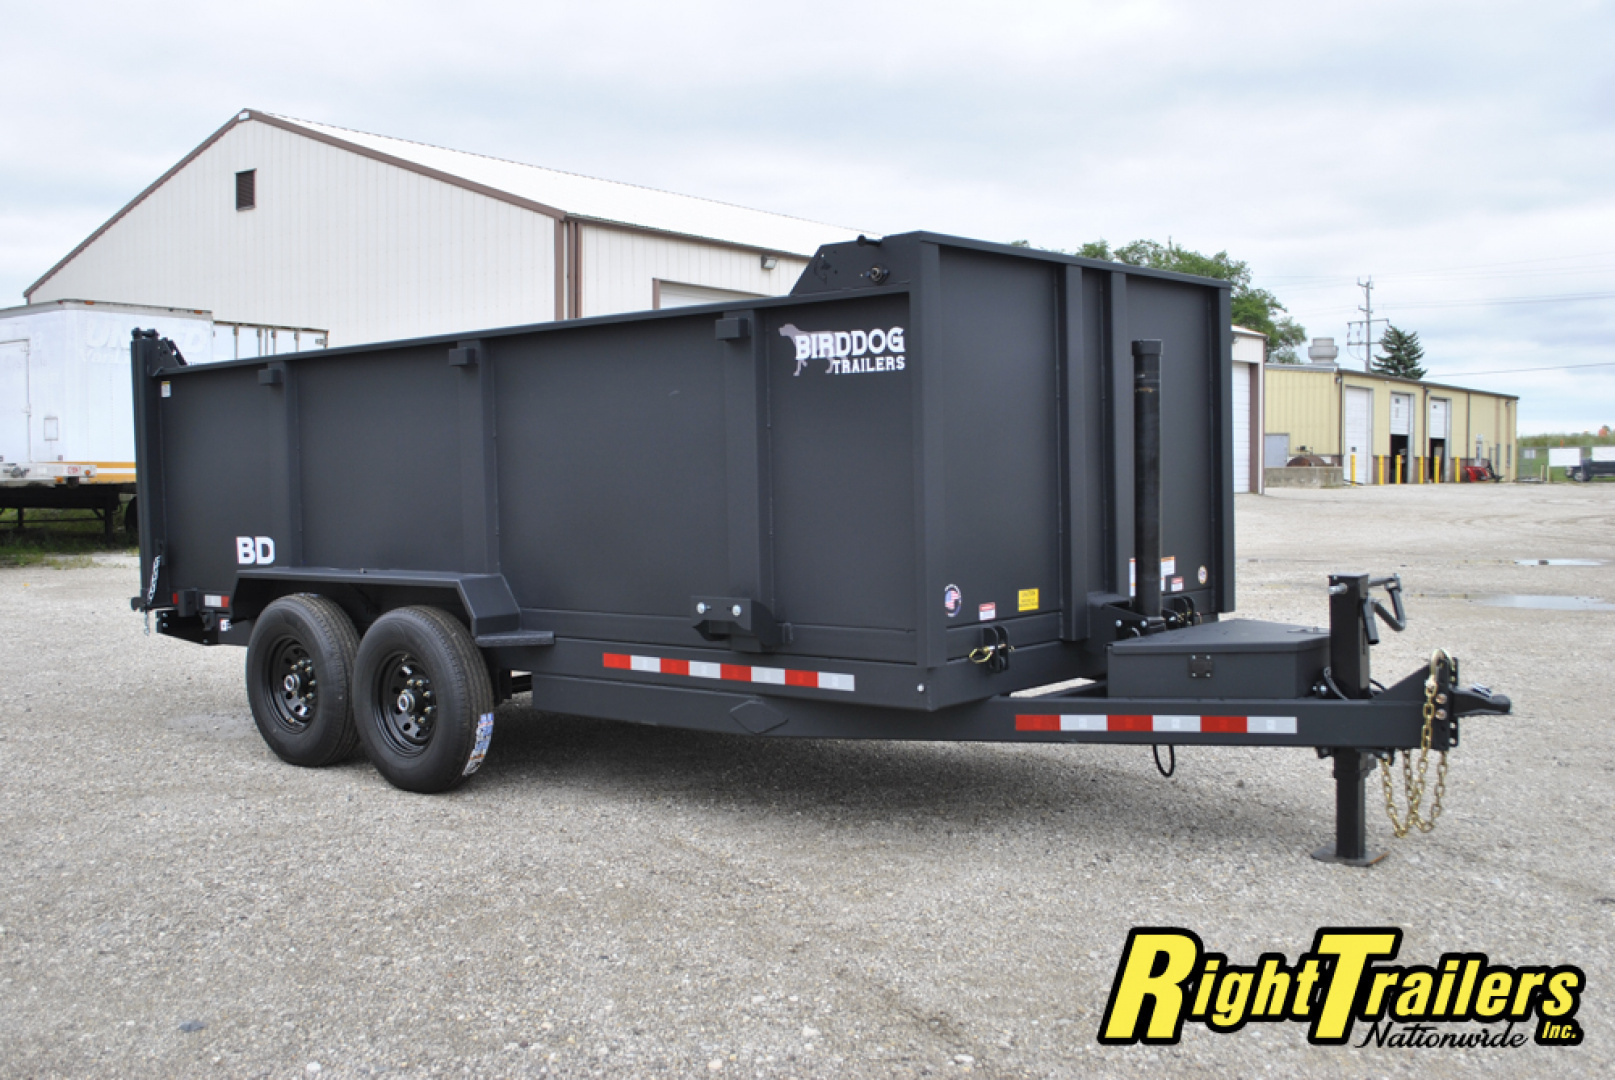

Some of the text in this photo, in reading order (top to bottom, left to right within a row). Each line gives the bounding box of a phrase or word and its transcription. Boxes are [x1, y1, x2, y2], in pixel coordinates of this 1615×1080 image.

[795, 326, 906, 360] BIRDDOG
[832, 355, 906, 375] TRAILERS
[236, 536, 276, 566] BD
